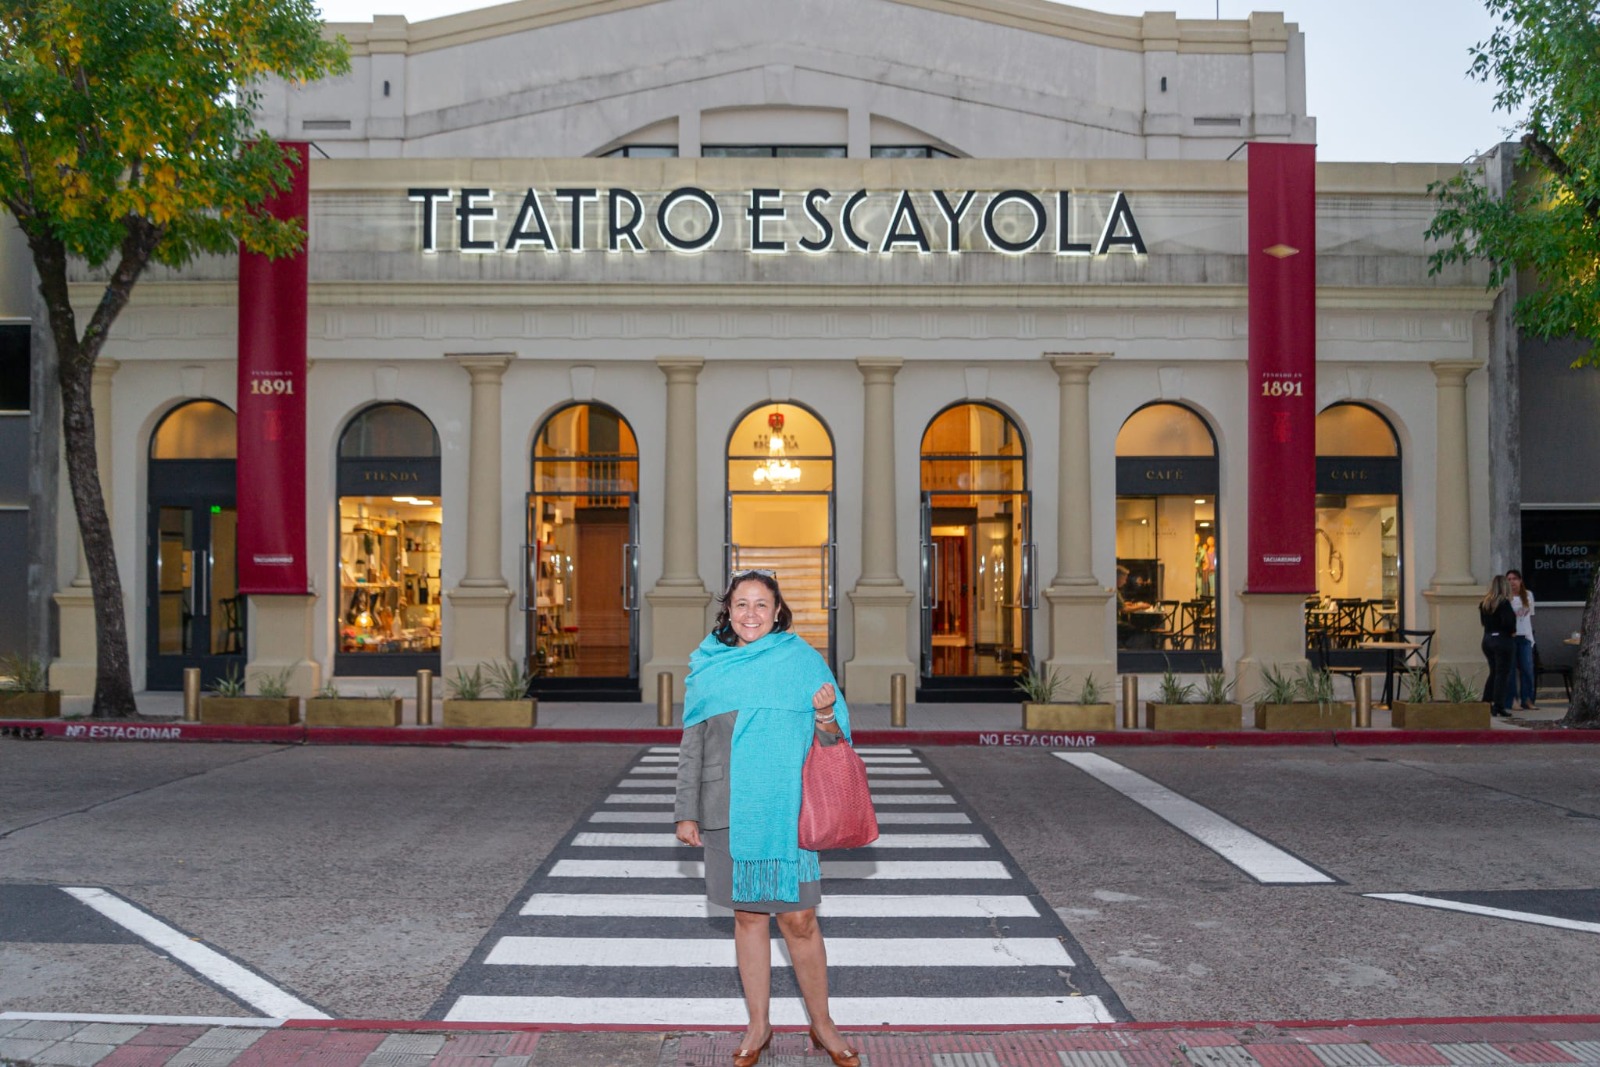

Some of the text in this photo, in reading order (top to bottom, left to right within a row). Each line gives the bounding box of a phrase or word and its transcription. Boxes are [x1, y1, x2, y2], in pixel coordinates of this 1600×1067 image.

[407, 187, 1148, 255] TEATRO ESCAYOLA
[250, 379, 294, 395] 1891
[1262, 381, 1303, 397] 1891
[363, 471, 418, 481] TIENDA
[1544, 544, 1588, 556] Museo
[1535, 559, 1553, 569] Del
[66, 725, 182, 739] NO ESTACIONAR
[979, 733, 1096, 747] NO ESTACIONAR
